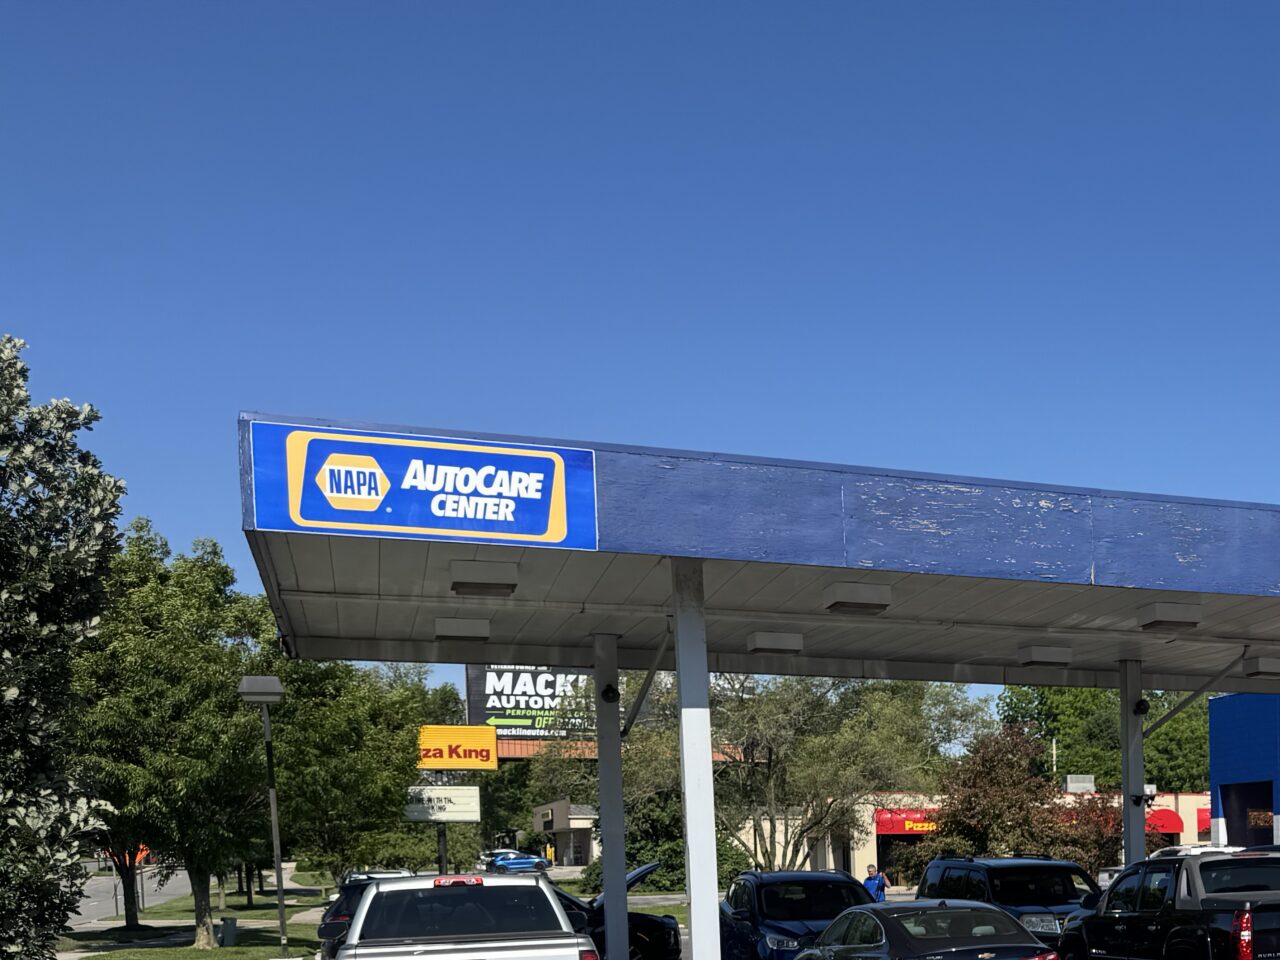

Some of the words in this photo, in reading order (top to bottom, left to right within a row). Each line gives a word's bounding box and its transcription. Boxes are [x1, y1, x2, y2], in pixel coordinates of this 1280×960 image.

[329, 468, 379, 497] NAPA
[430, 494, 515, 521] CENTER
[448, 744, 490, 762] King
[905, 820, 937, 831] Pizza
